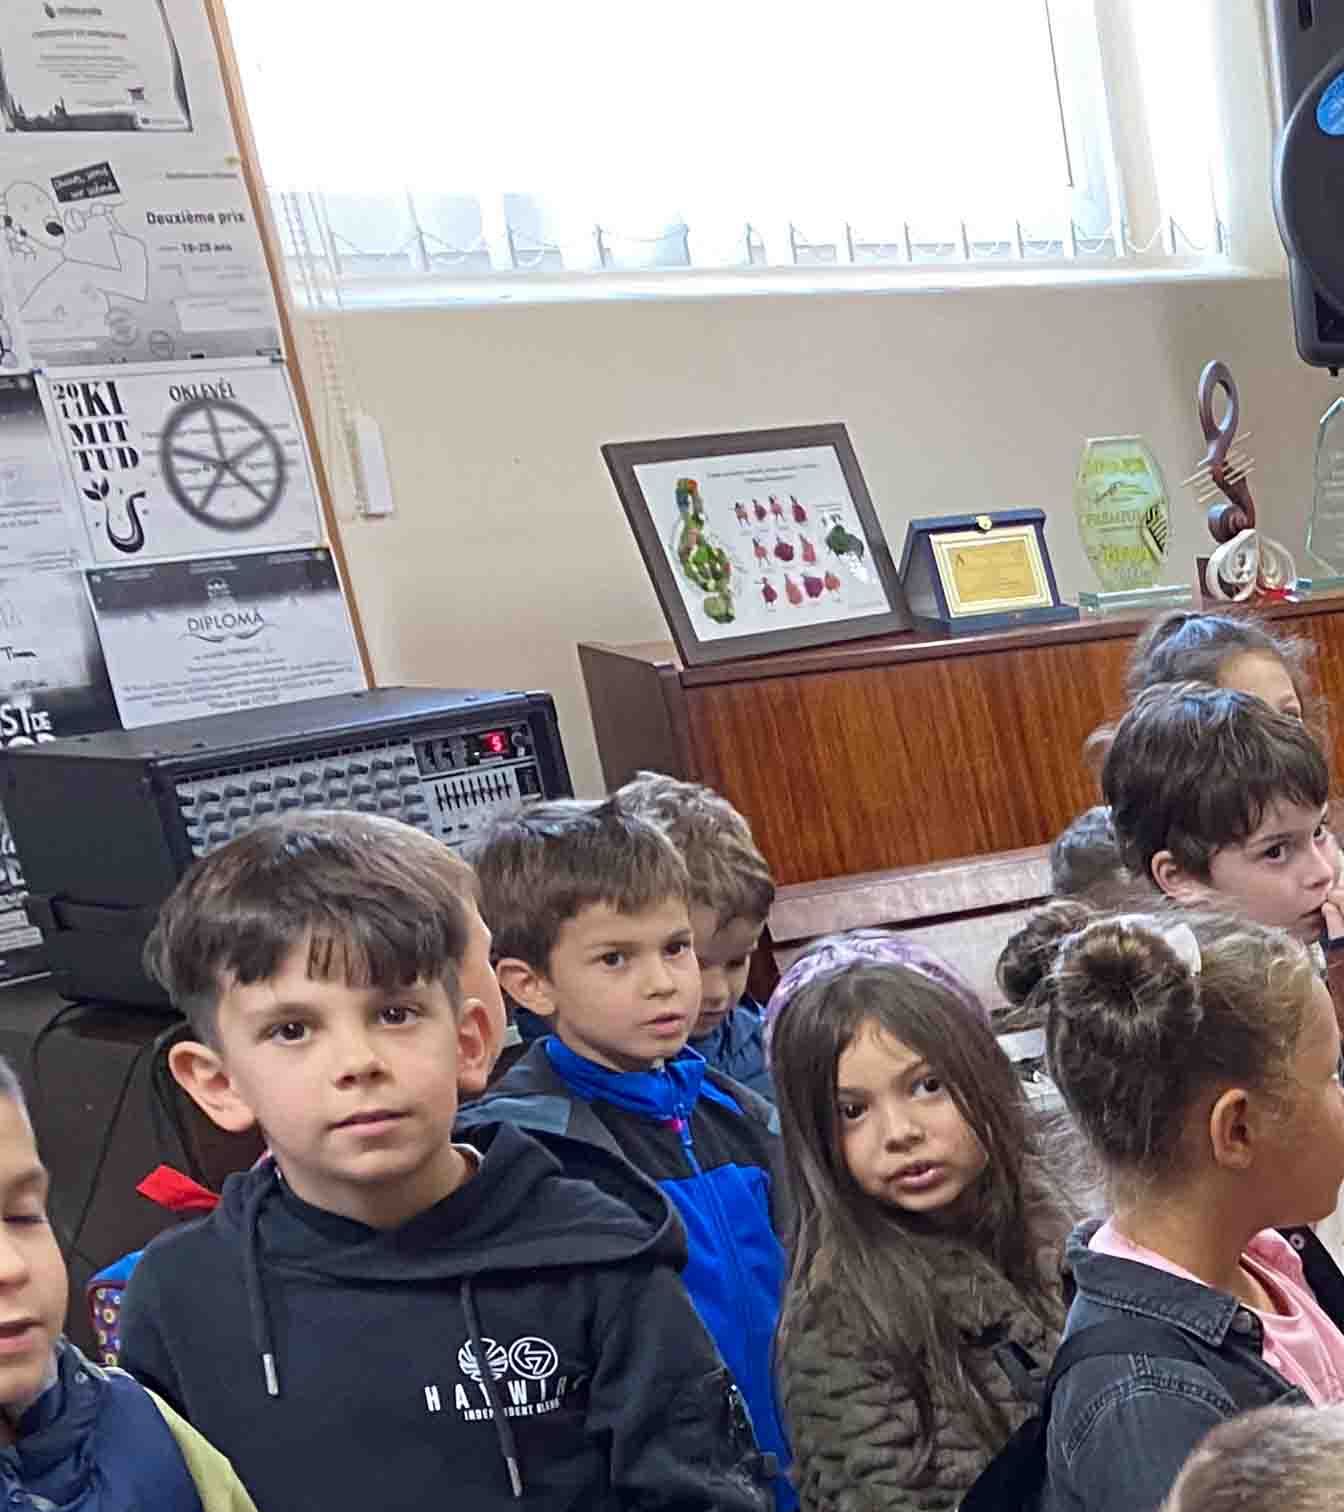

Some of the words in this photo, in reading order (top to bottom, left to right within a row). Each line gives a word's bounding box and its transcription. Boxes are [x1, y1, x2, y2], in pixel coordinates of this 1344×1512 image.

[218, 210, 246, 227] prix
[169, 377, 236, 401] OKLEVÉL
[187, 611, 264, 632] DIPLOMA
[464, 1402, 534, 1421] INDEPDENT
